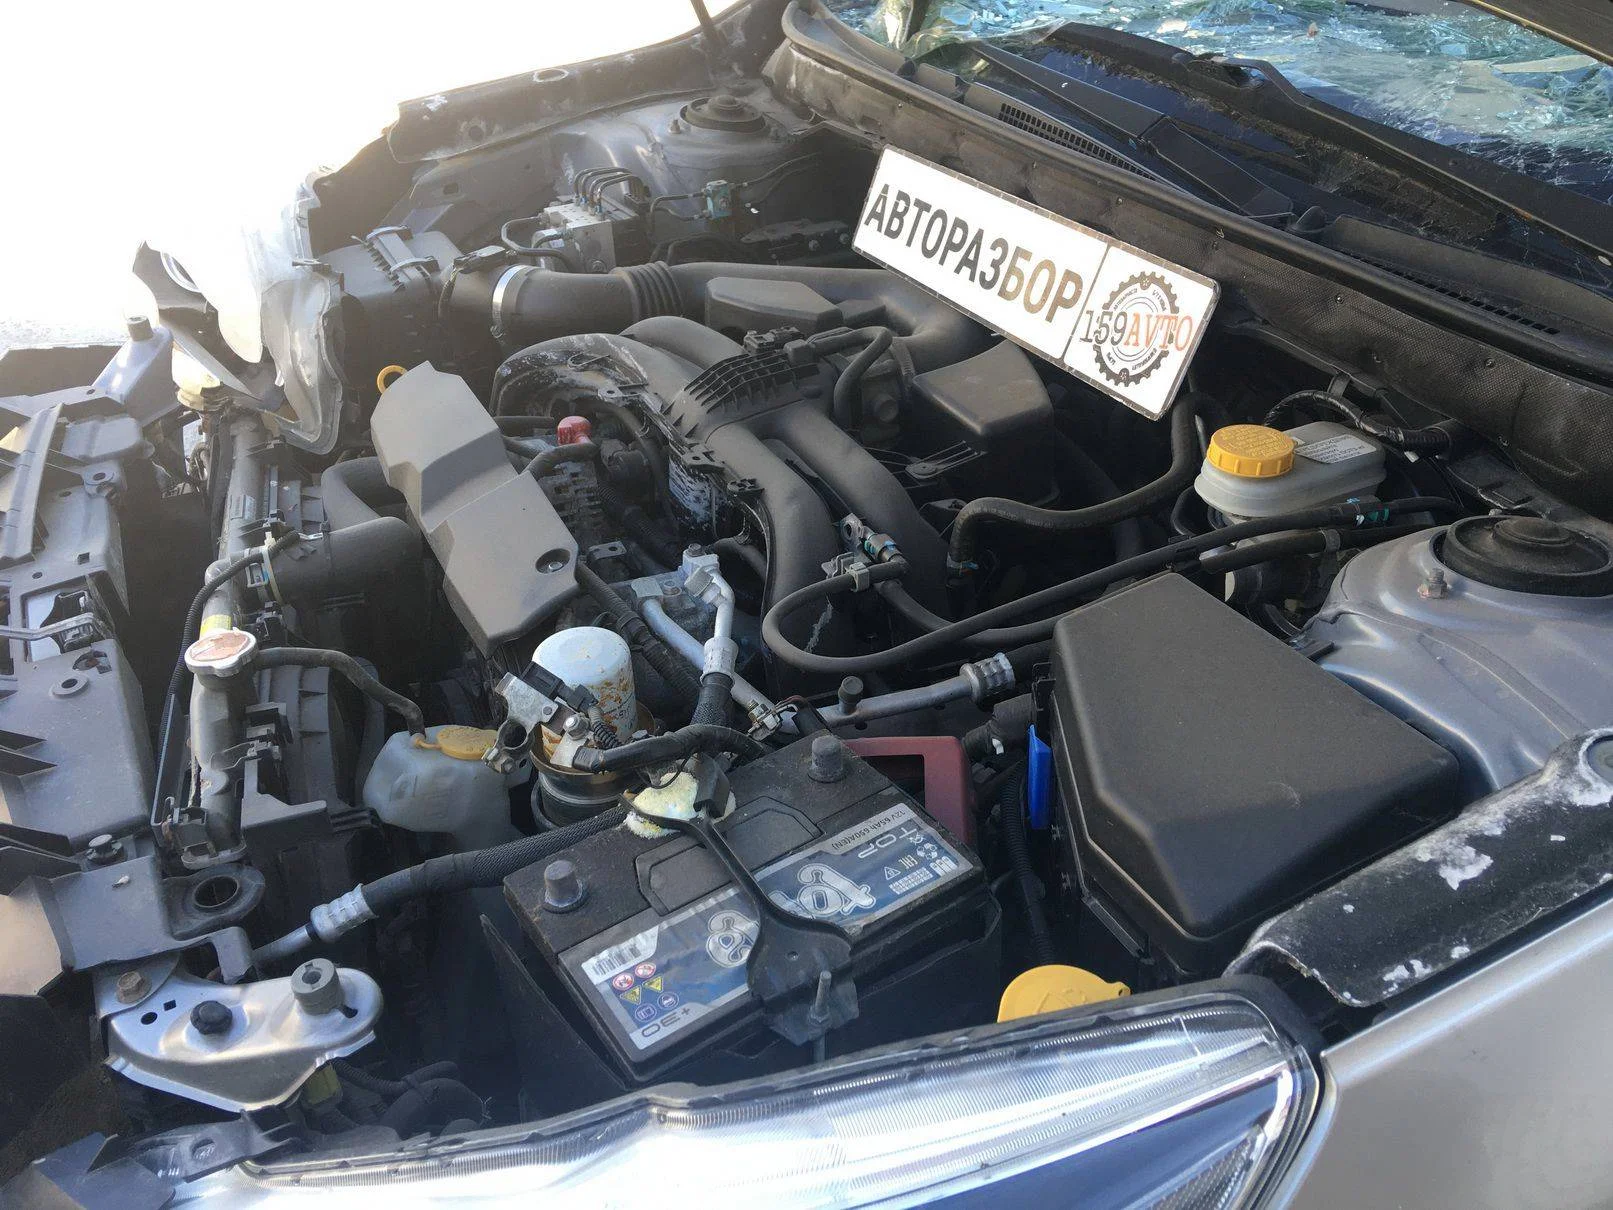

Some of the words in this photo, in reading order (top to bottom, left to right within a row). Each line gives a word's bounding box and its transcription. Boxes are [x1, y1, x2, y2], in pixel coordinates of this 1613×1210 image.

[864, 184, 1083, 324] АВТОРАЗБОР
[871, 817, 891, 831] 65Ah
[891, 810, 906, 820] 12V
[858, 827, 917, 859] TOP
[641, 1007, 691, 1038] OE+
